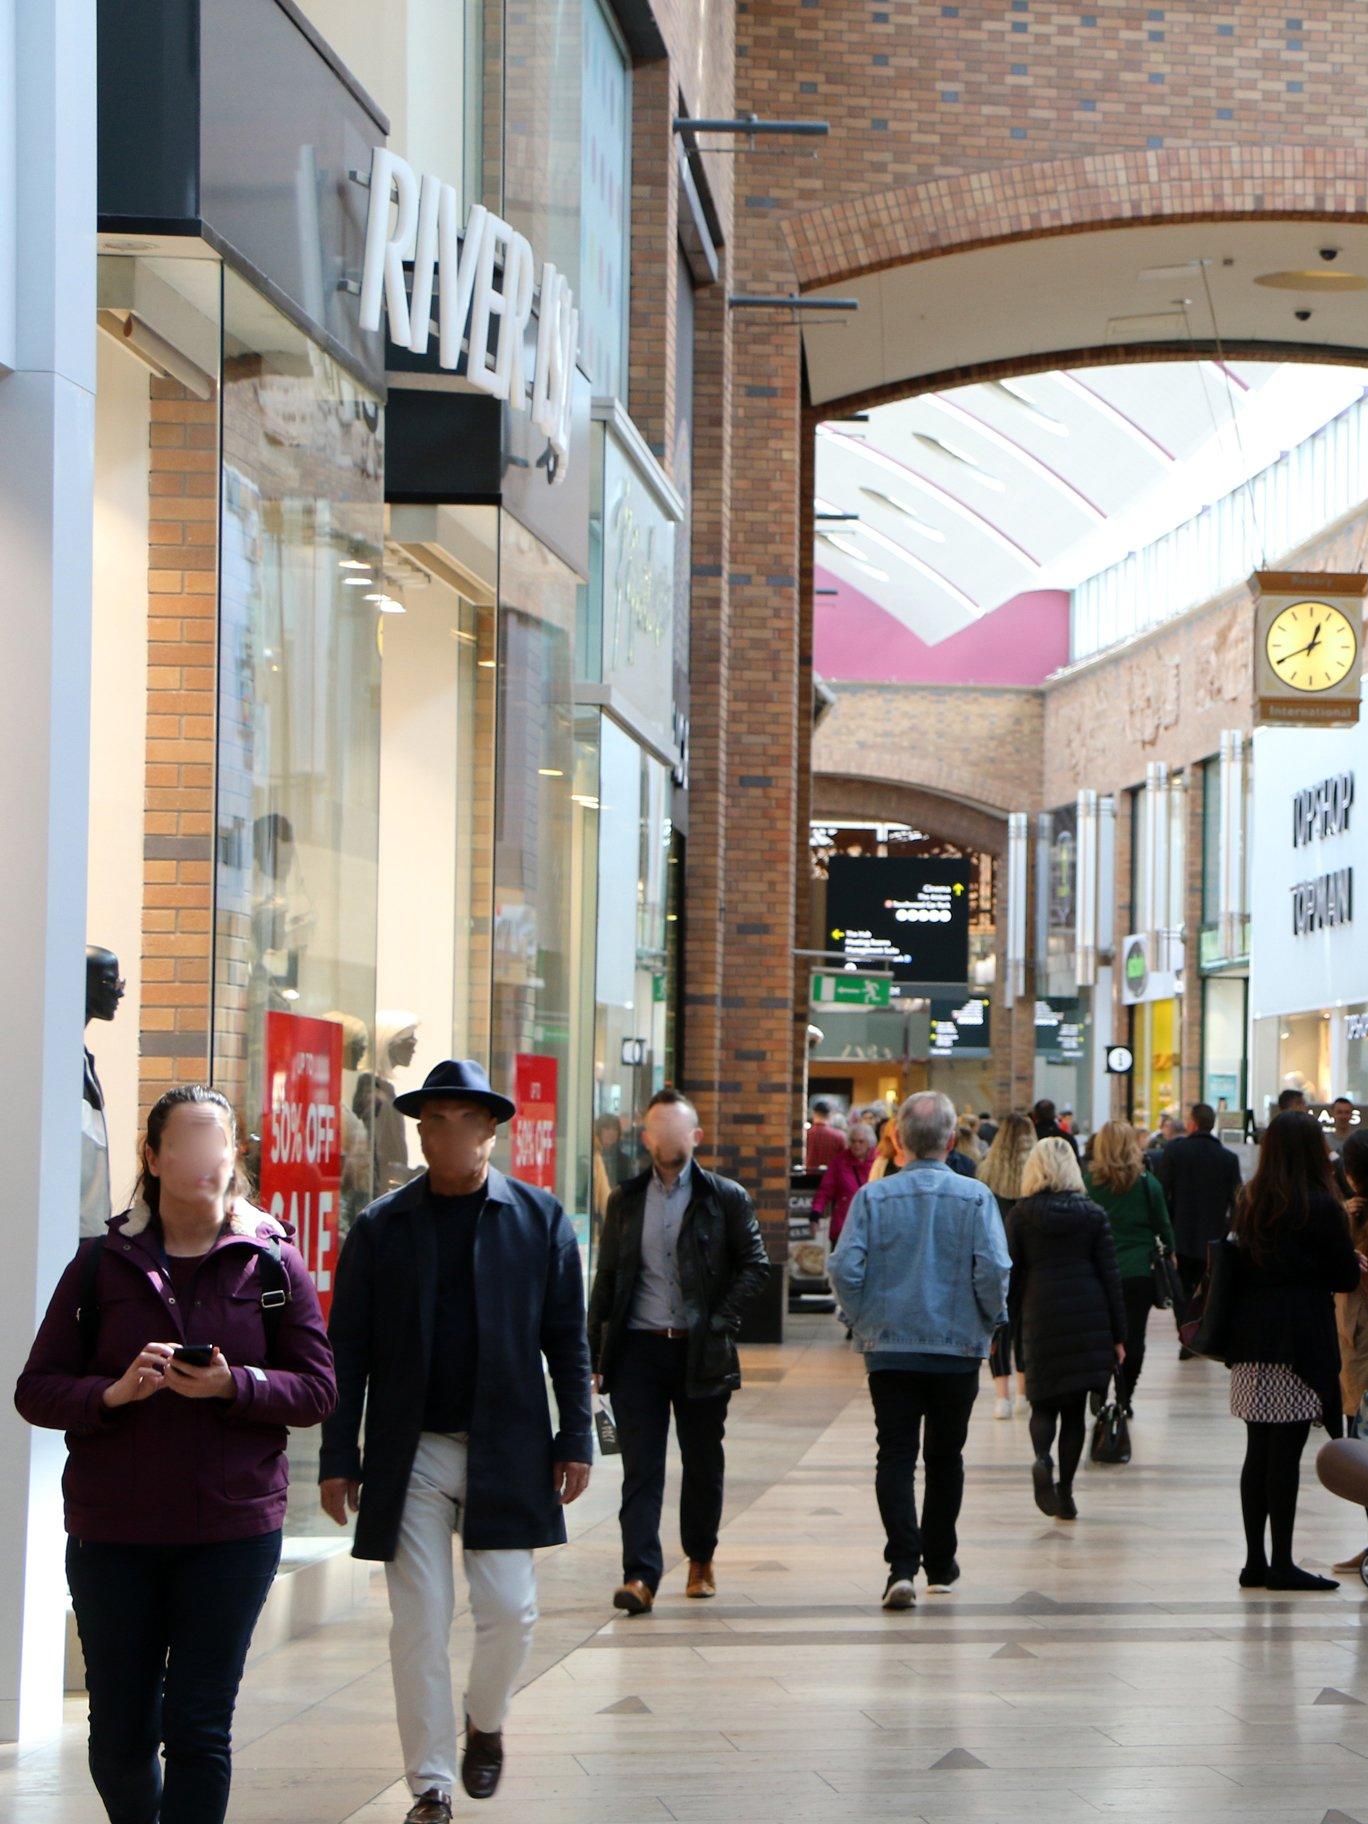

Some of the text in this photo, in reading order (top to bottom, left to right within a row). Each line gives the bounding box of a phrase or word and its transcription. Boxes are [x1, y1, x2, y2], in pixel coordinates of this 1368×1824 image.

[358, 146, 535, 412] RIVER
[1268, 705, 1352, 719] International
[271, 1101, 336, 1164] 50% OFF
